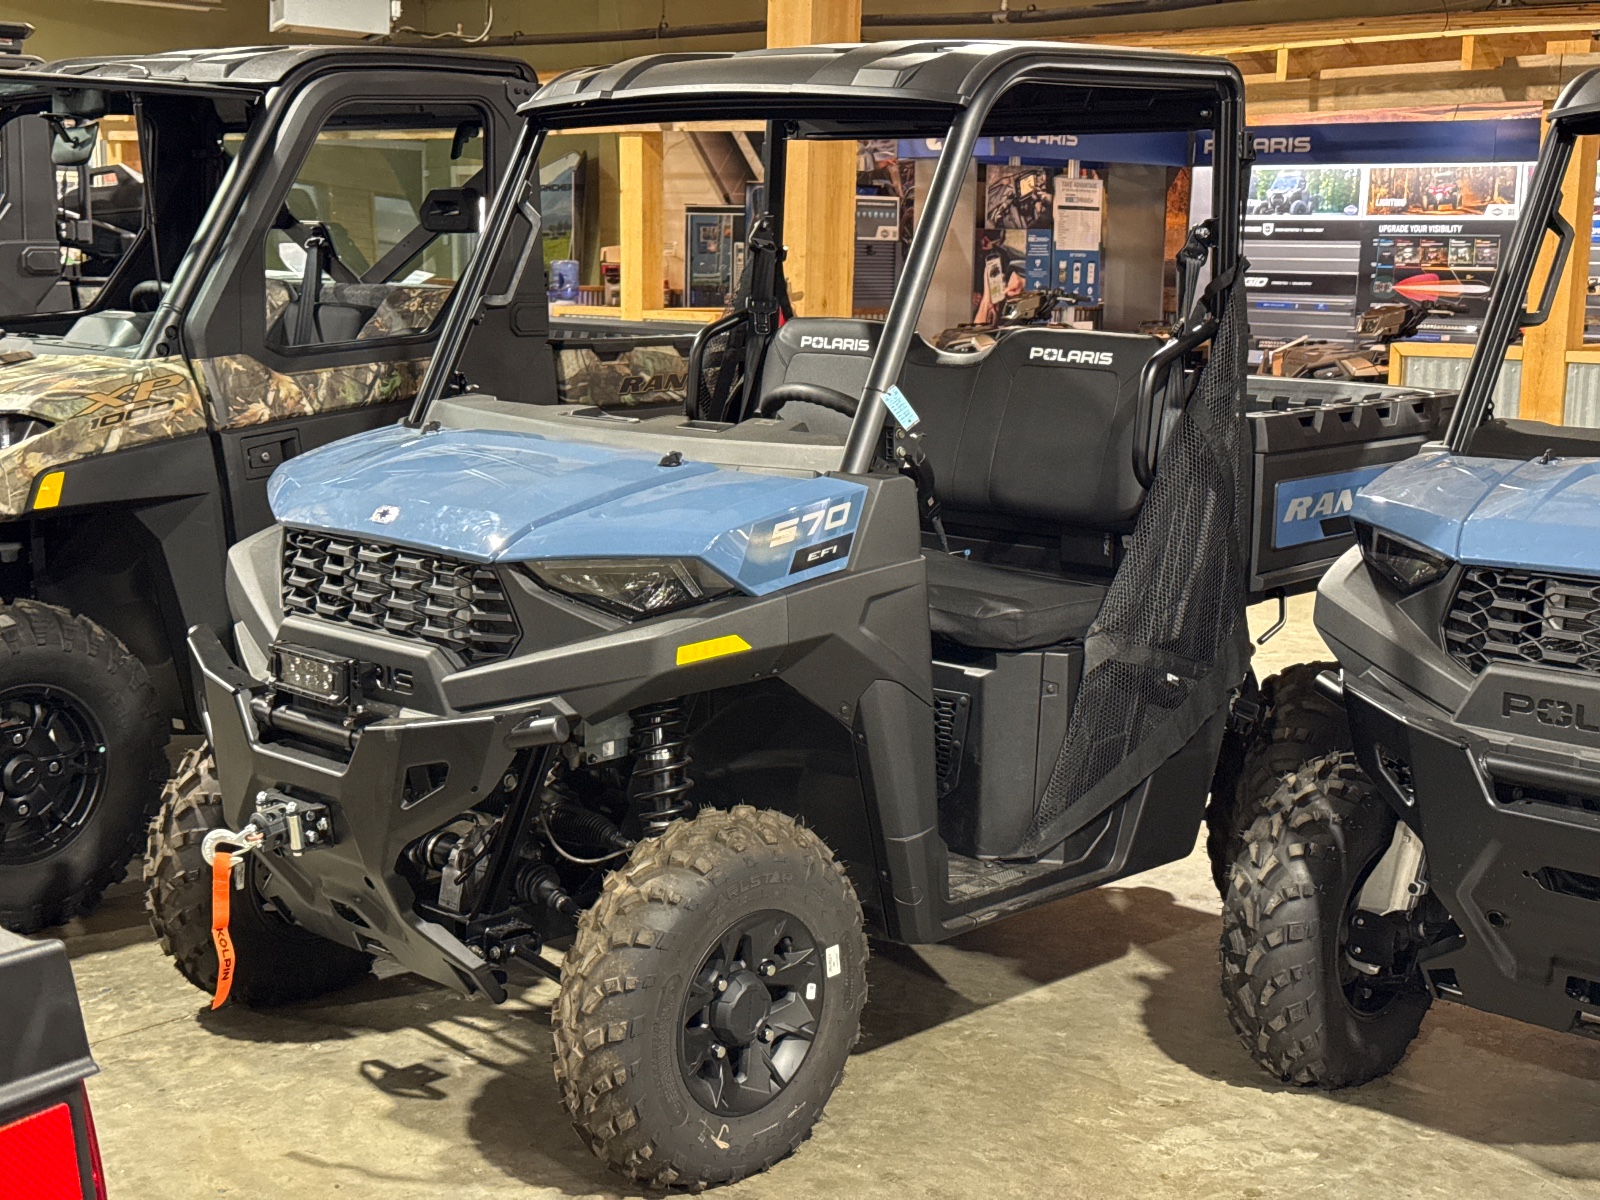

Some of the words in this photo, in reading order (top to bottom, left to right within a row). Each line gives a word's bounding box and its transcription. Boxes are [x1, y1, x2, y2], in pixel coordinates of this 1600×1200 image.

[1203, 136, 1311, 154] PARIS
[1378, 224, 1409, 233] UPGRADE
[1409, 224, 1428, 234] YOUR
[1428, 224, 1463, 234] VISIBILITY
[799, 335, 870, 352] POLARIS
[1029, 346, 1114, 366] POLARIS
[71, 374, 187, 419] XP
[807, 544, 838, 562] EFI
[215, 927, 232, 982] KOLPIN
